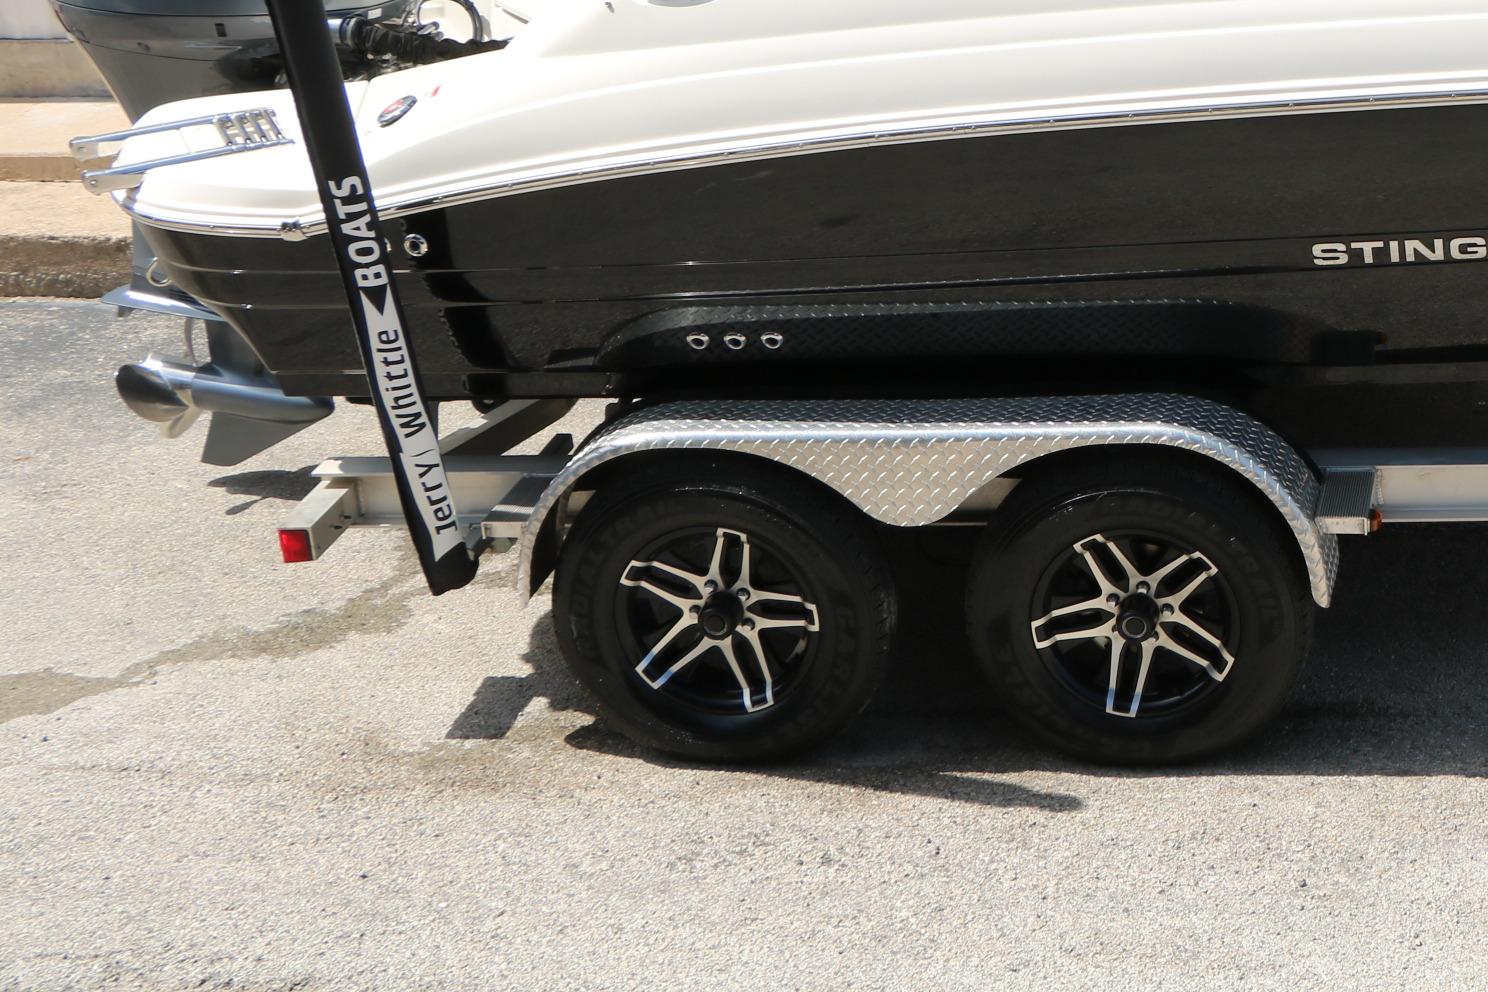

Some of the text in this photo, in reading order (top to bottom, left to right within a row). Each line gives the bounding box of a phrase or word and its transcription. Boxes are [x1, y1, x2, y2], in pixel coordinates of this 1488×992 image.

[327, 175, 458, 535] Jerry Whittle BOATS
